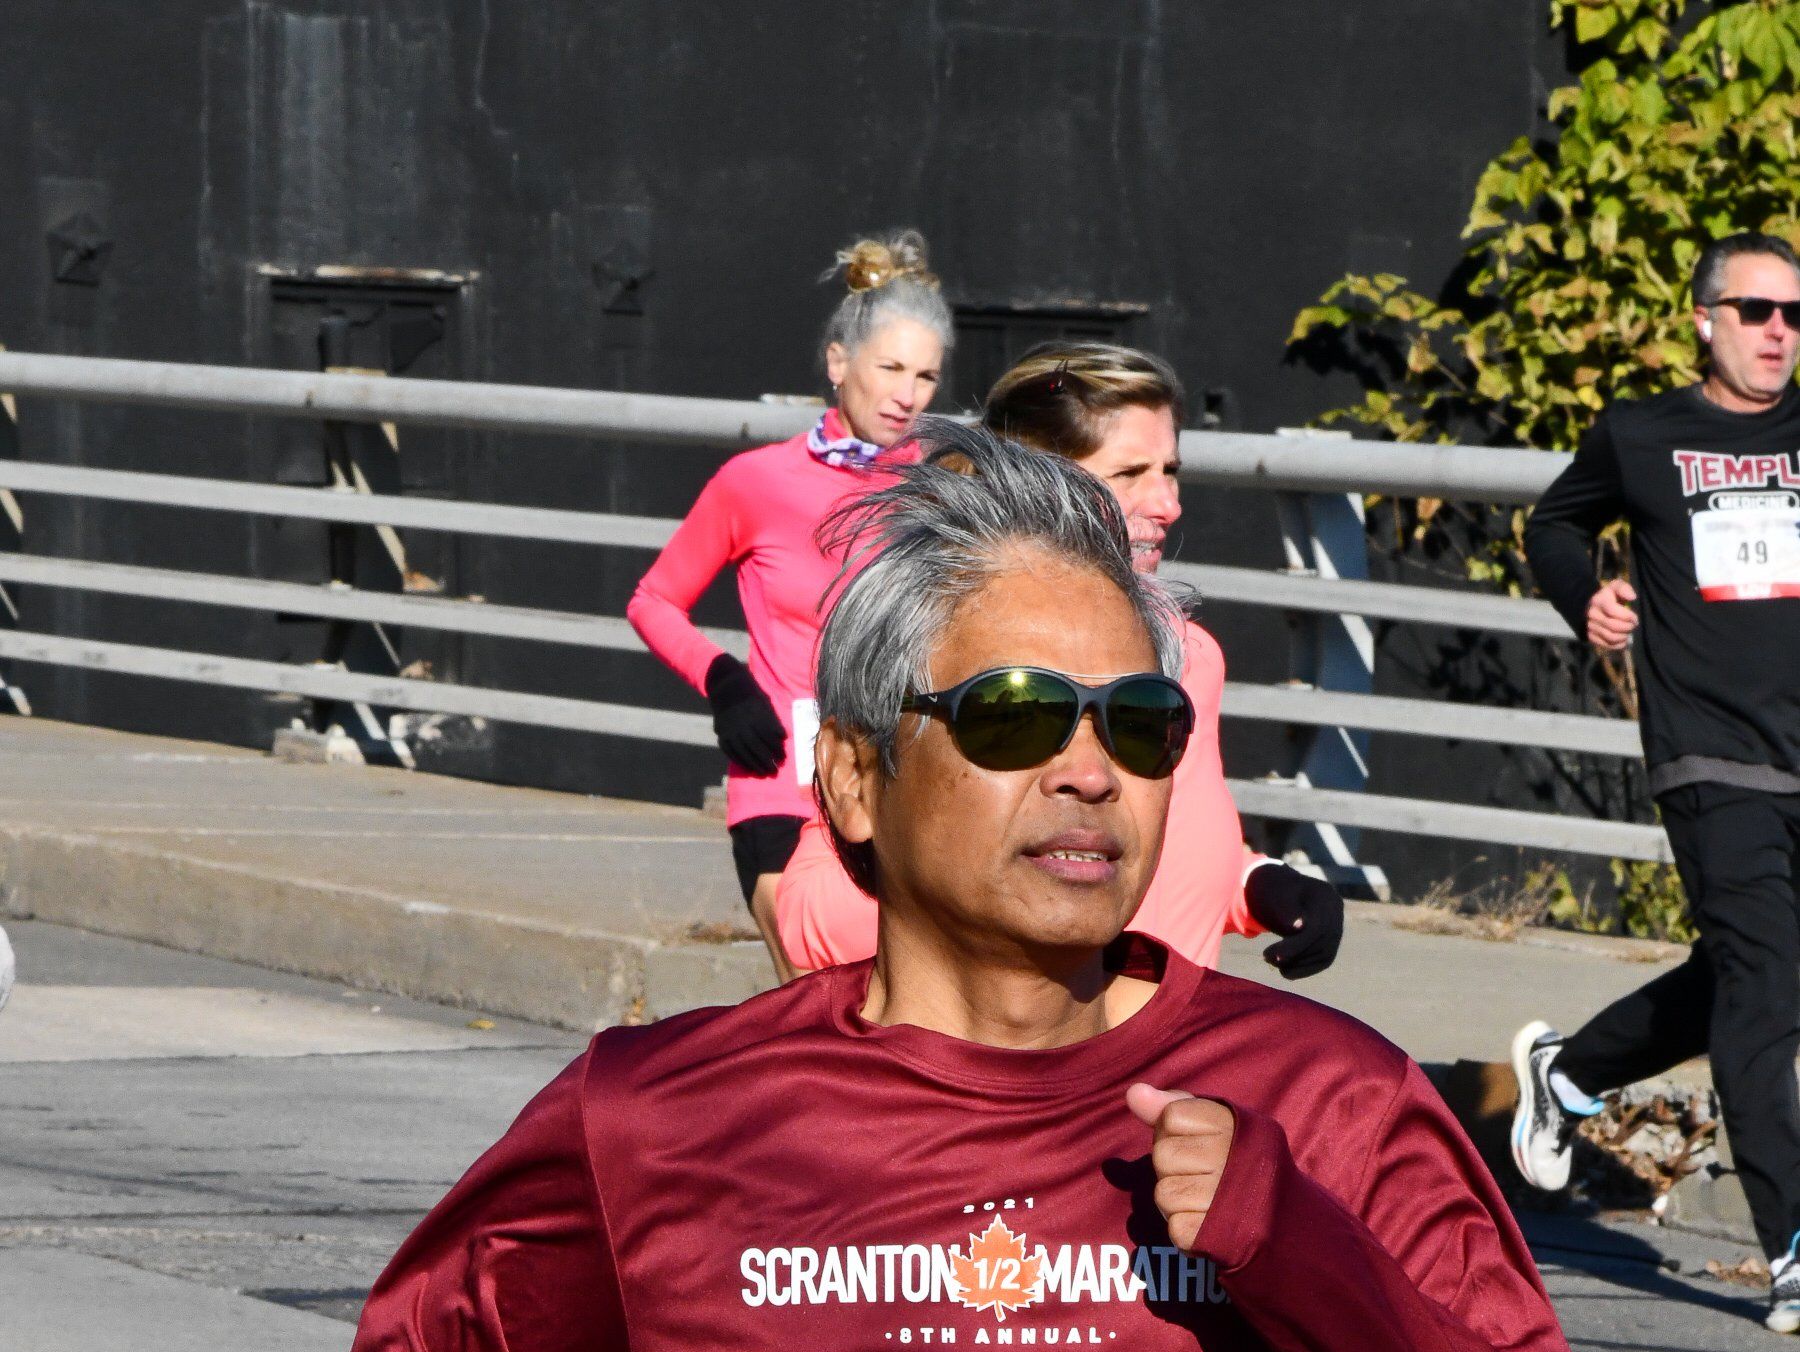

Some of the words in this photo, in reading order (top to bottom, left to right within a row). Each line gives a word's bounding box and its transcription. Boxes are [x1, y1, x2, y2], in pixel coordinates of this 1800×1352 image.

[1673, 450, 1800, 497] TEMPL
[1737, 540, 1768, 564] 49
[963, 1197, 1034, 1214] 2021
[739, 1244, 961, 1306] SCRANTON
[973, 1258, 1021, 1290] 1/2
[1034, 1244, 1231, 1303] MARATHO
[899, 1327, 957, 1344] 8TH
[974, 1327, 1102, 1345] ANNUAL
